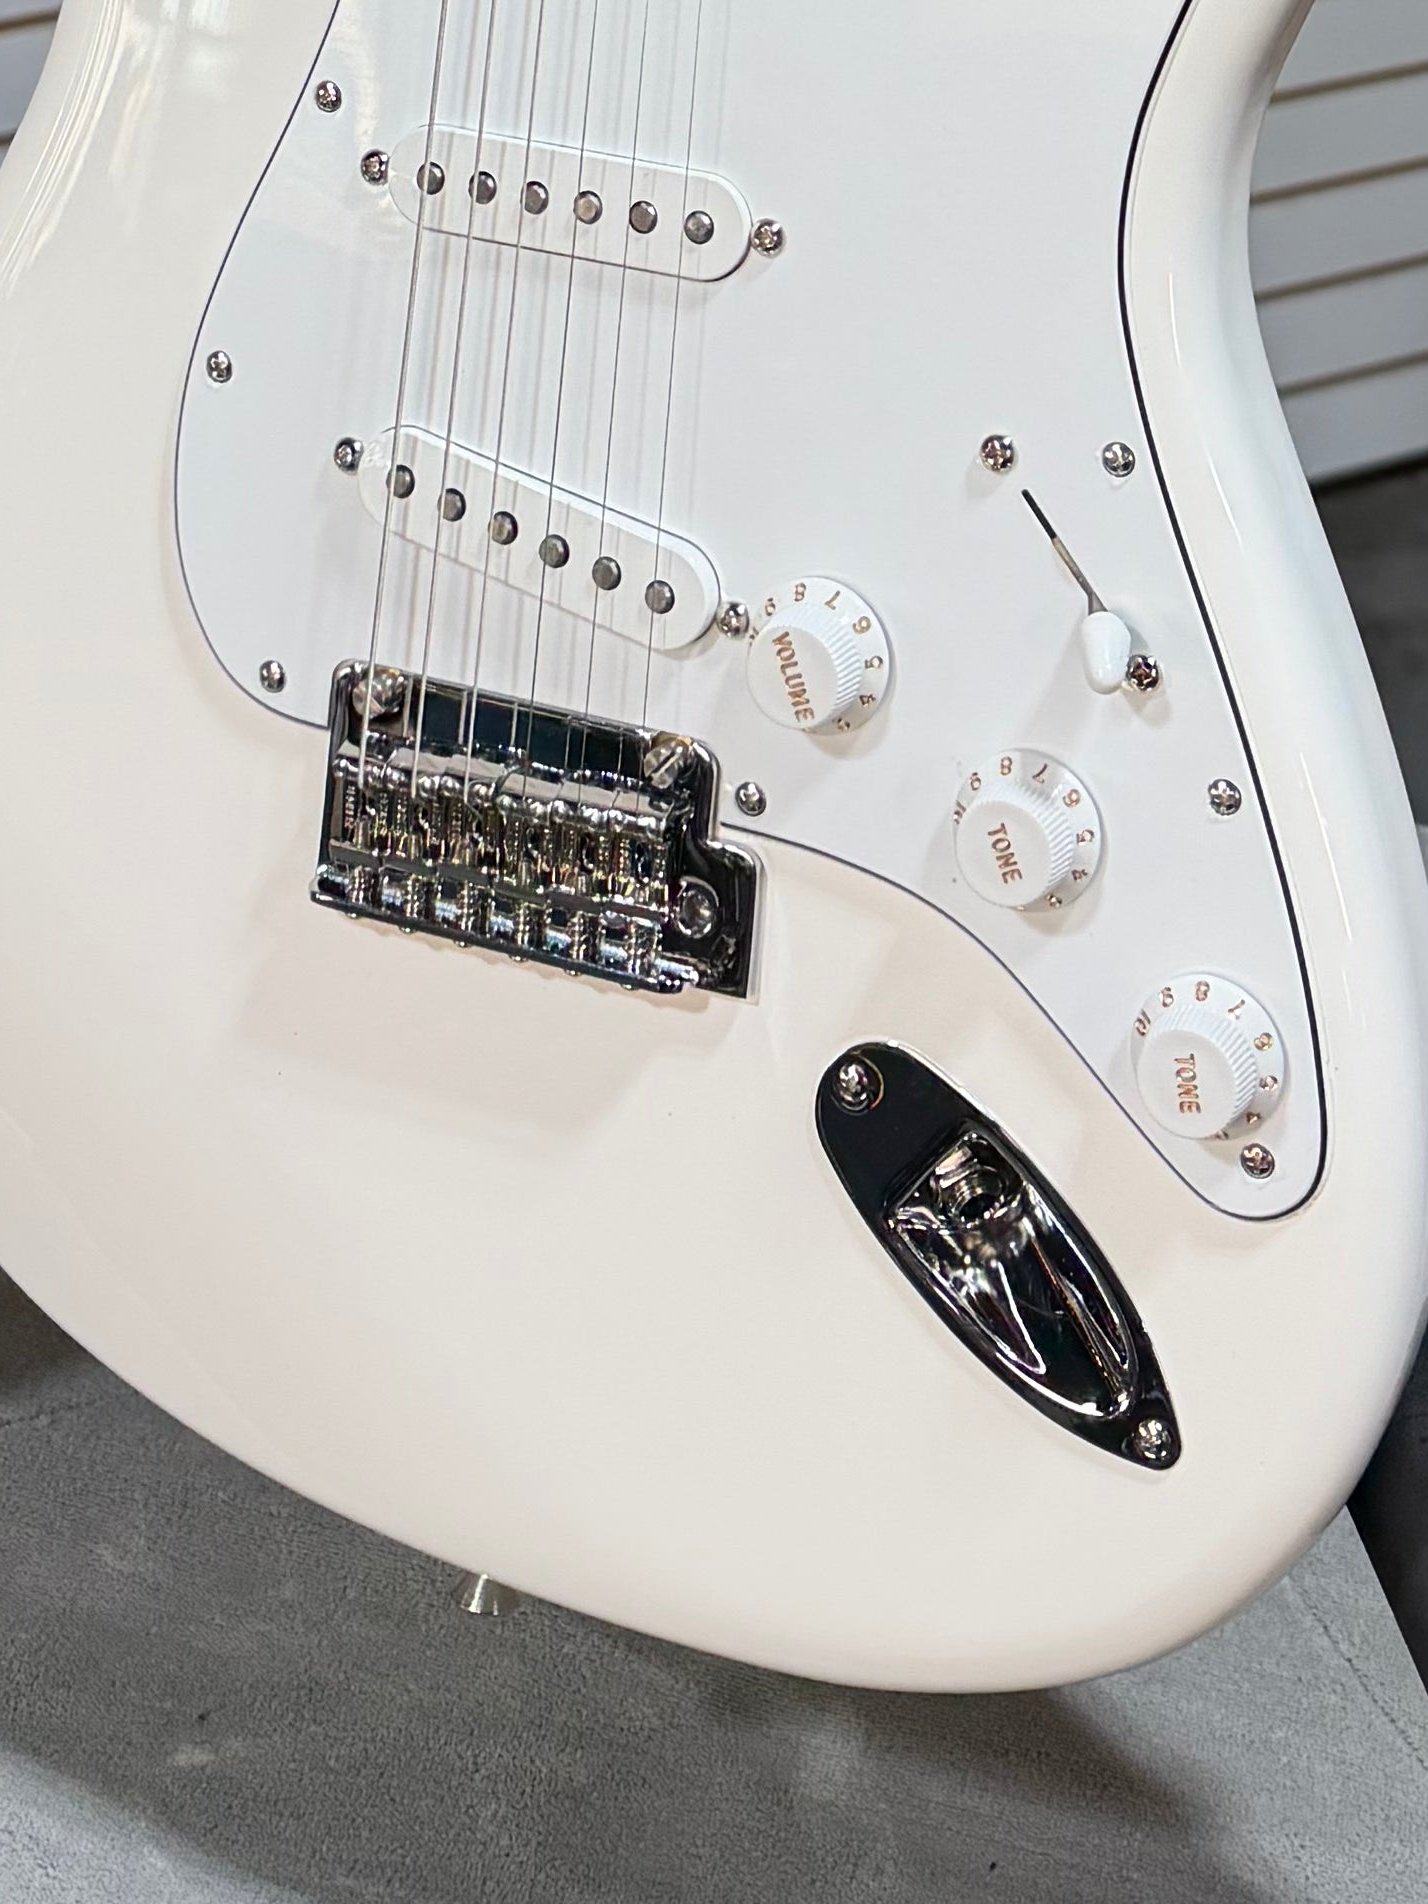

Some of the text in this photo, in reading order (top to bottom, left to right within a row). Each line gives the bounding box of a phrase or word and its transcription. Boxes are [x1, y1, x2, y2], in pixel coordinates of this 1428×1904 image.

[771, 630, 815, 723] VOLUME
[987, 822, 1023, 884] TONE
[1173, 1052, 1202, 1114] TONE
